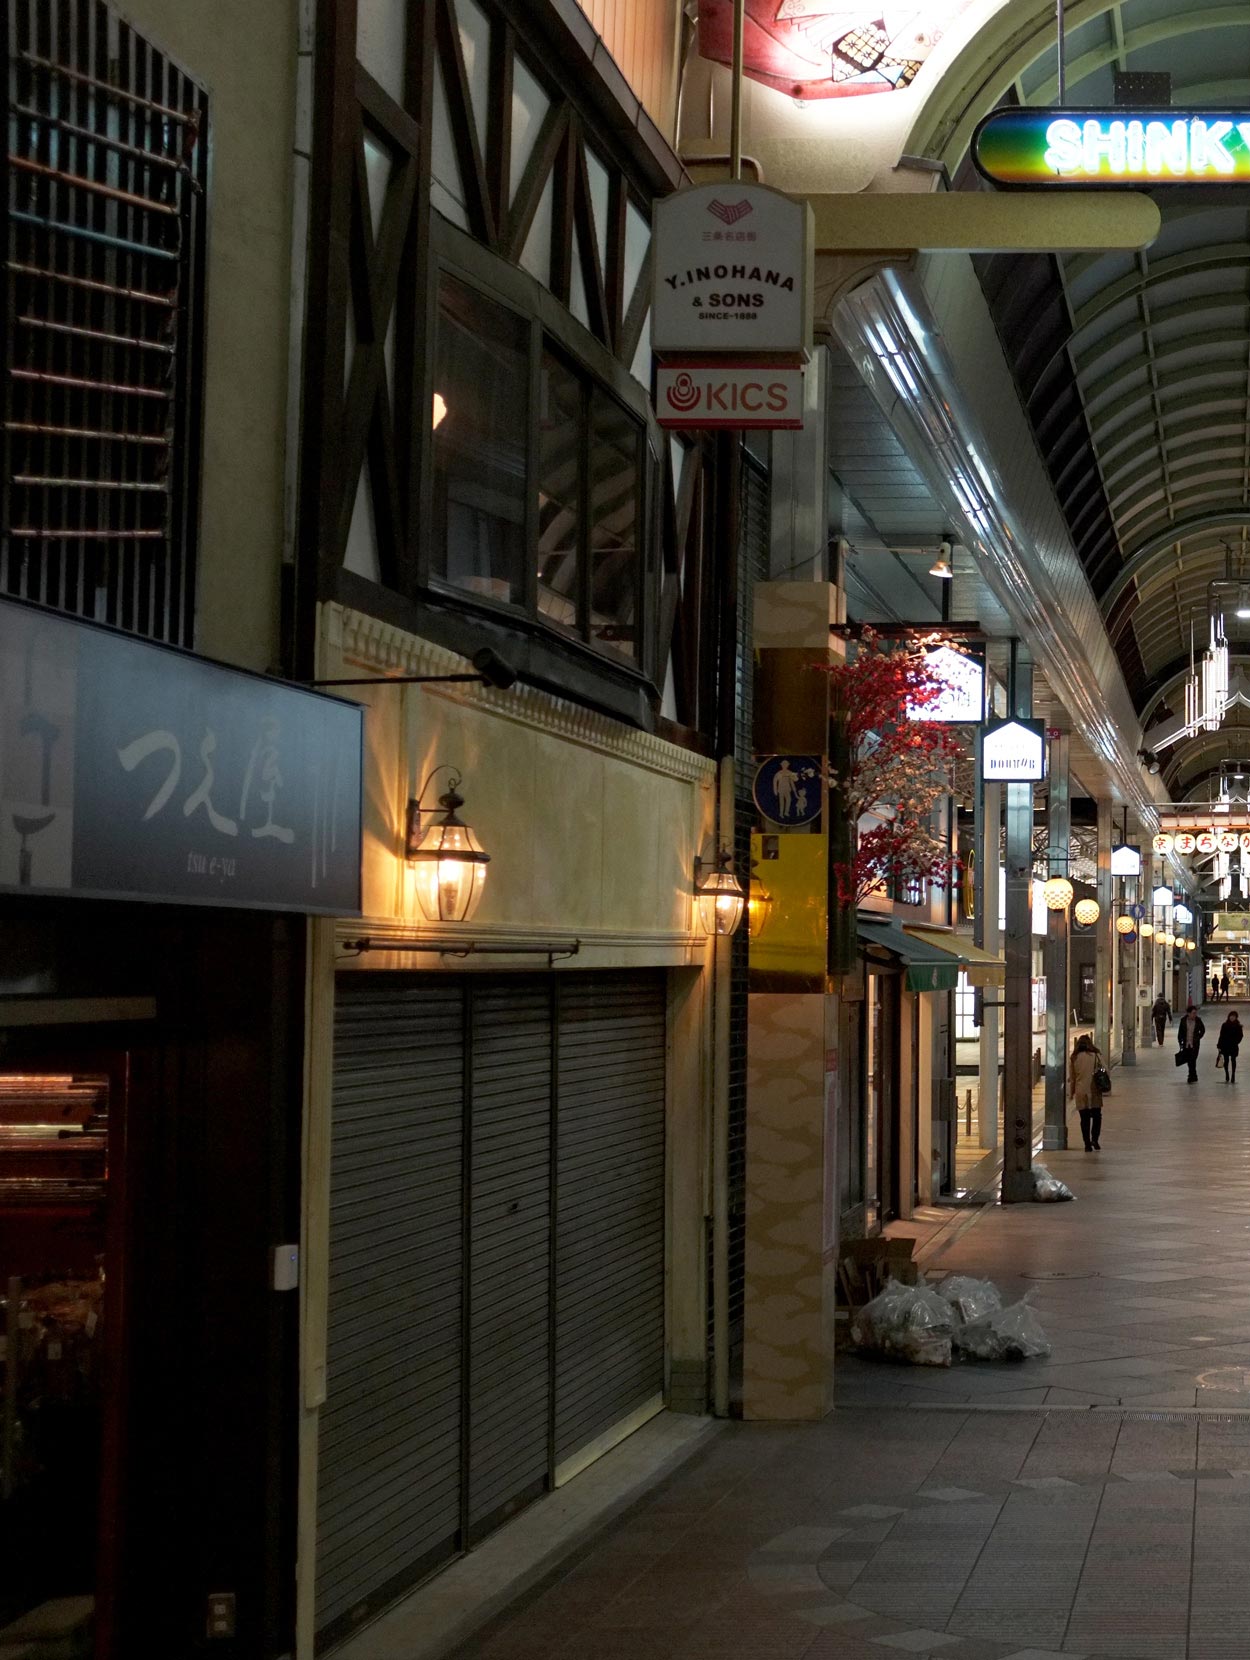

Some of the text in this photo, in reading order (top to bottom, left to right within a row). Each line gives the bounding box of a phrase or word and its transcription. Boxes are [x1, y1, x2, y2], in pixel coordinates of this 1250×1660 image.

[664, 264, 796, 292] Y.INOHANA
[692, 293, 765, 308] & SONS
[706, 382, 790, 413] KICS
